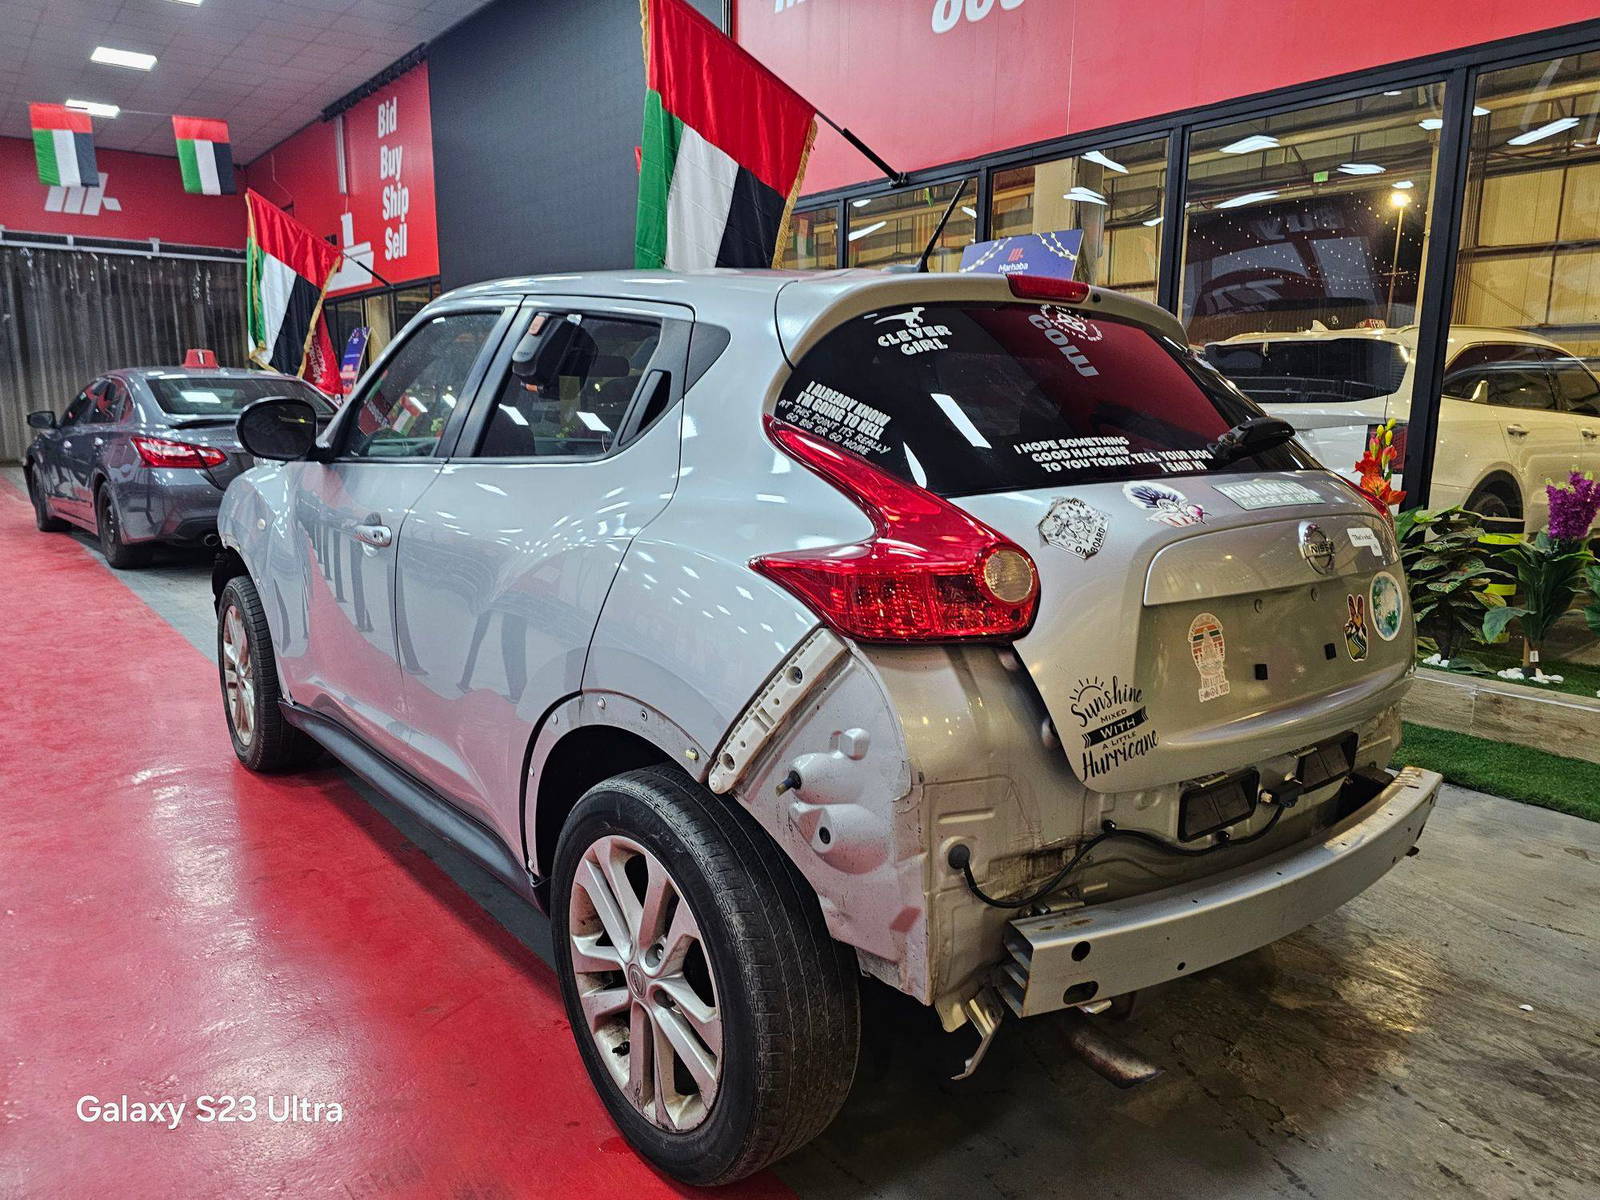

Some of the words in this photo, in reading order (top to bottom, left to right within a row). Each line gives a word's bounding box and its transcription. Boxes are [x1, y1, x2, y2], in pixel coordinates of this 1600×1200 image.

[378, 96, 397, 138] Bid
[380, 145, 403, 181] Buy
[382, 181, 409, 222] Ship
[385, 223, 407, 261] Sell
[998, 262, 1028, 272] Marhaba
[877, 325, 953, 347] CLEVER
[901, 338, 949, 355] GIRL
[805, 380, 816, 393] I
[810, 383, 858, 412] ALREADY
[795, 390, 815, 408] I'M
[811, 398, 846, 422] GOING
[843, 412, 861, 428] TO
[857, 419, 884, 440] HELL
[853, 402, 892, 427] KNOW
[778, 399, 794, 409] AT
[793, 404, 812, 418] THIS
[811, 413, 840, 430] POINT
[854, 433, 892, 454] REALLY
[799, 418, 815, 429] BIG
[814, 425, 828, 437] OR
[828, 432, 843, 443] GO
[842, 438, 871, 455] HOME
[1013, 444, 1022, 455] I
[1020, 439, 1058, 454] HOPE
[1058, 436, 1130, 451] SOMETHING
[1032, 449, 1071, 463] GOOD
[1071, 446, 1130, 459] HAPPENS
[1132, 452, 1161, 465] TELL
[1158, 449, 1191, 461] YOUR
[1189, 448, 1214, 460] DOG
[1041, 462, 1062, 473] TO
[1061, 458, 1091, 471] YOU
[1159, 463, 1170, 473] I
[1168, 461, 1194, 473] SAID
[1194, 460, 1208, 471] HI
[1090, 527, 1106, 553] BOARD
[1311, 542, 1334, 554] NISS
[1070, 675, 1143, 728] Sunshine
[1100, 708, 1127, 724] MIXED
[1100, 718, 1136, 739] WITH
[1102, 743, 1109, 751] A
[1111, 731, 1137, 746] LITTLE
[1082, 730, 1158, 784] Hurricane
